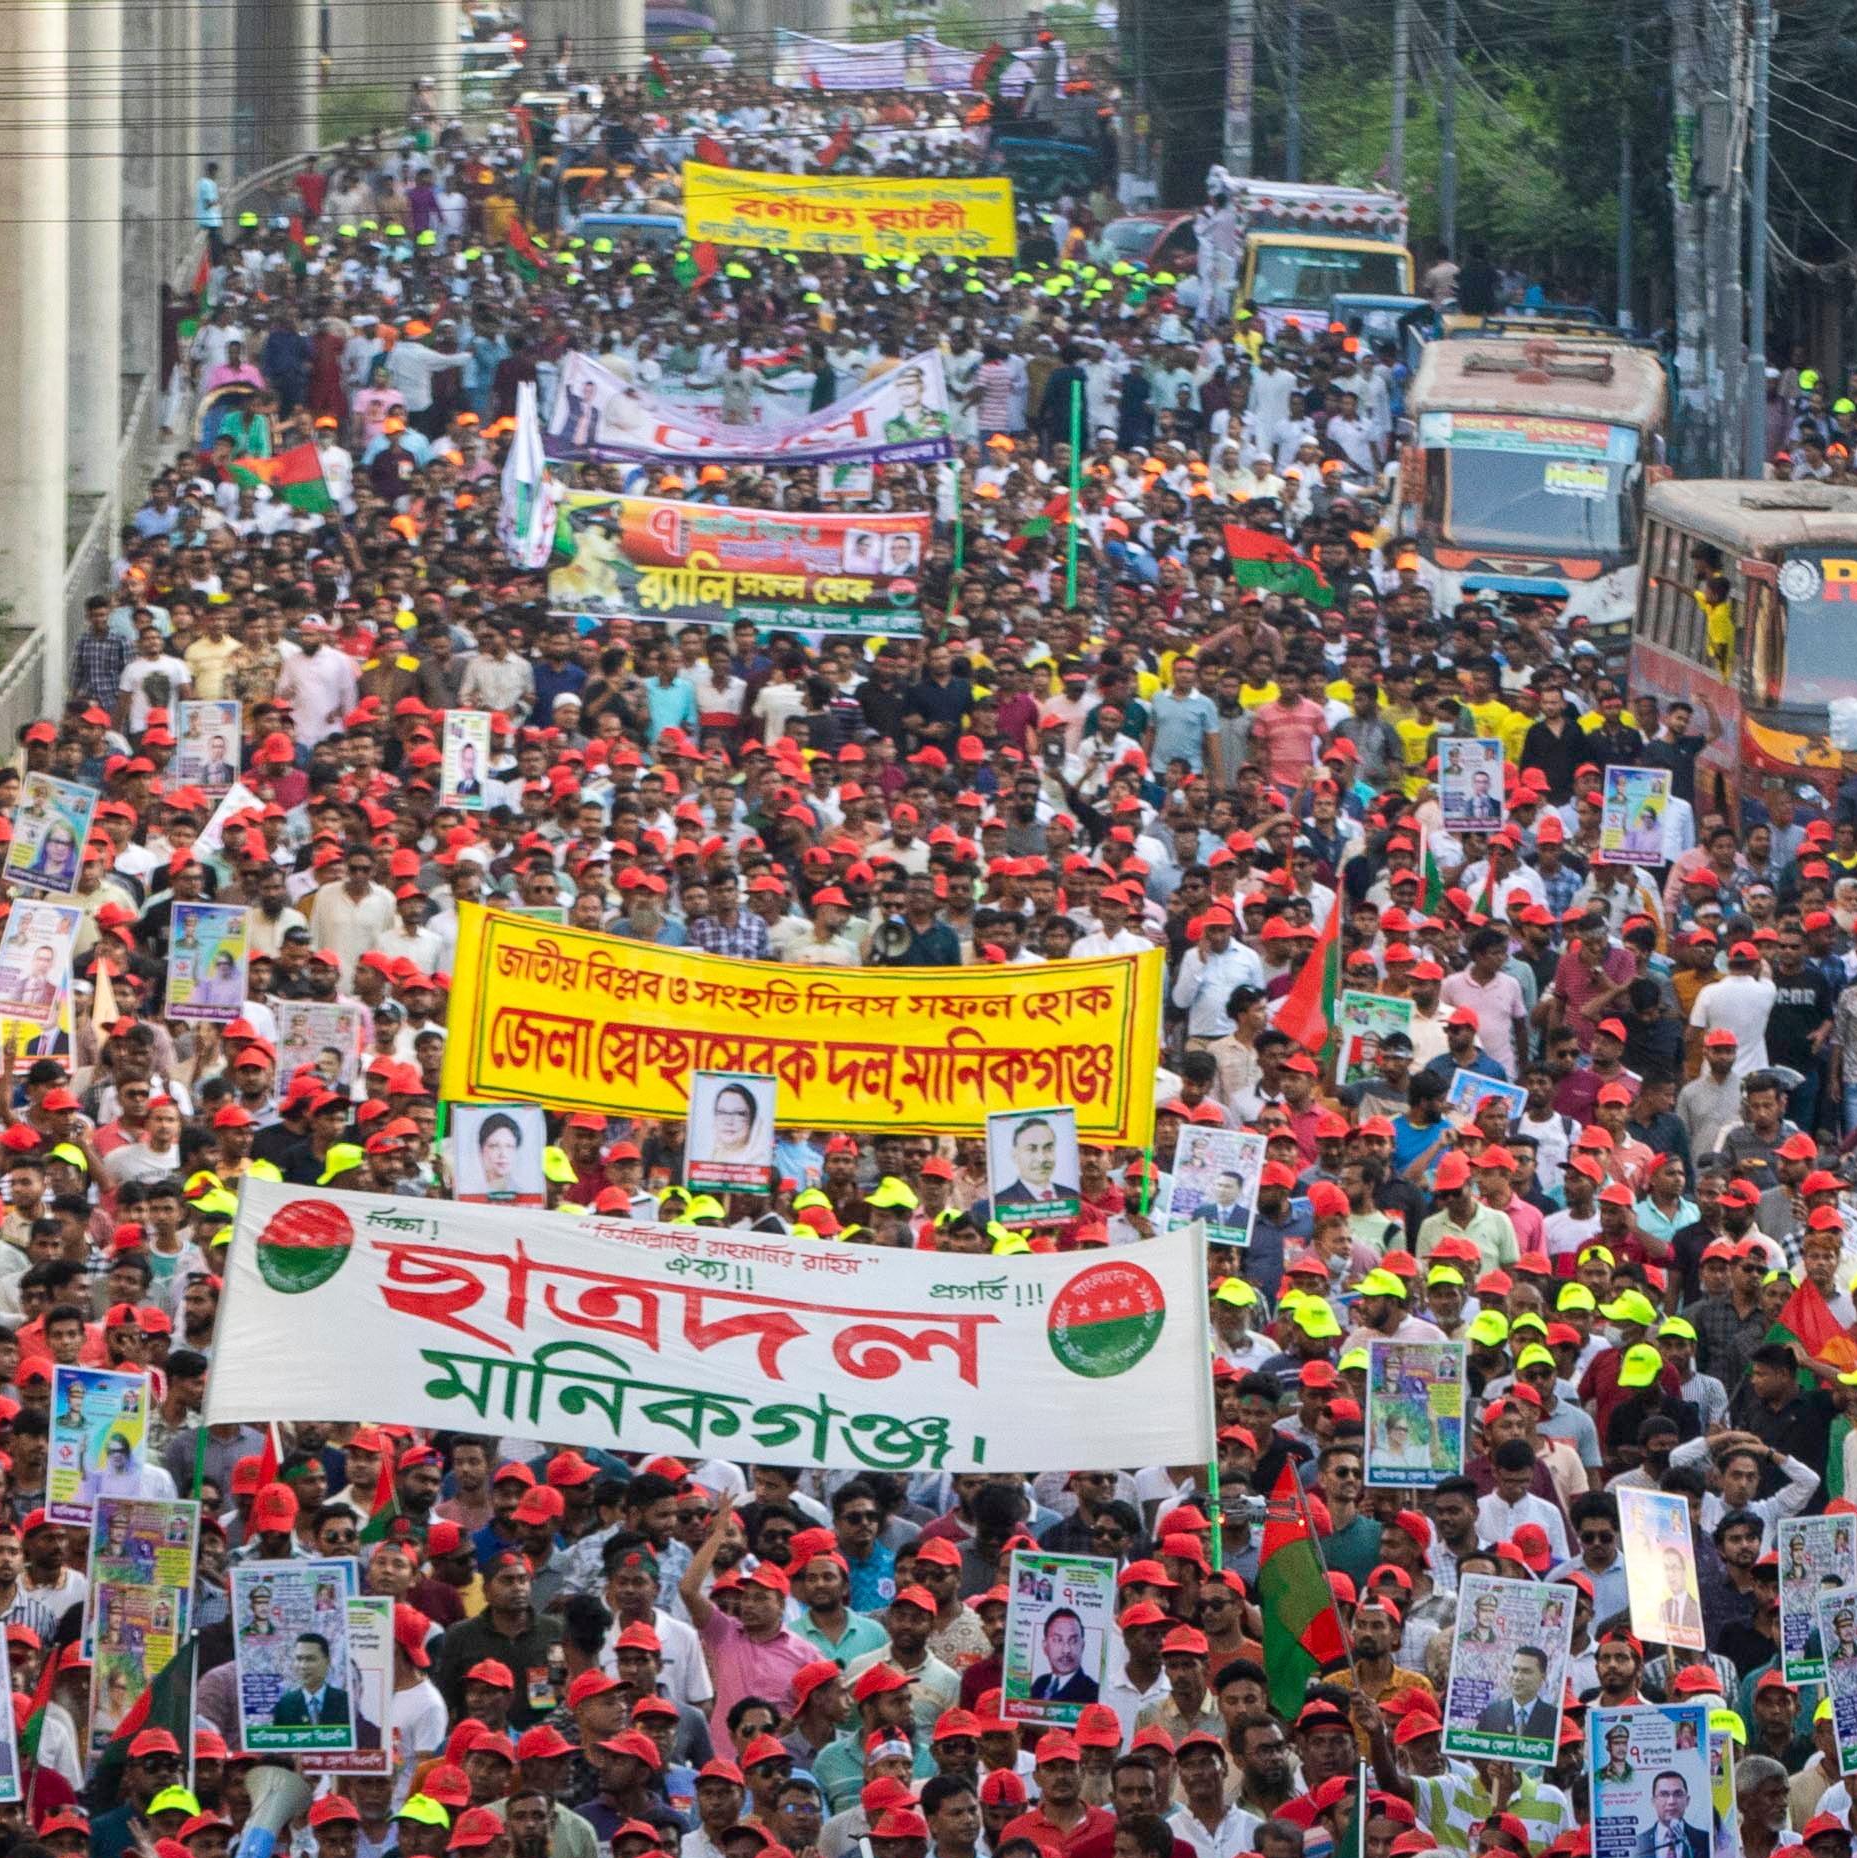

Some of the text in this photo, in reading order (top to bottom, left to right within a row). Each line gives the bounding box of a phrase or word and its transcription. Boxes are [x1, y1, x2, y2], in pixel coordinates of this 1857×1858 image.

[737, 577, 806, 600] সফল
[497, 939, 1114, 1025] জাতীয় বিপ্লব ও সংহতি দিবস সফল হোক
[491, 1006, 595, 1081] জেলা
[371, 1238, 1000, 1389] ছাত্রদল
